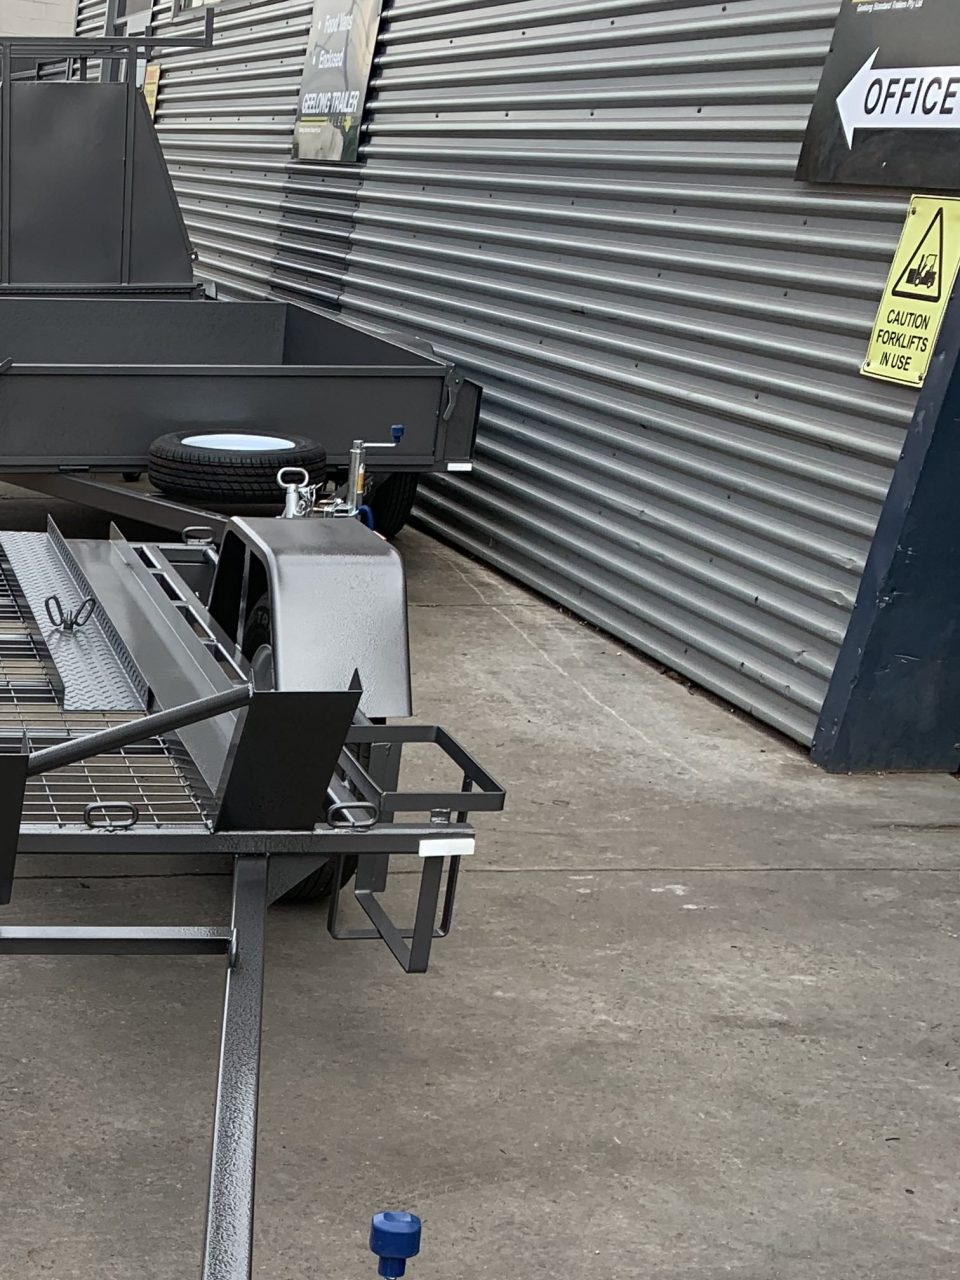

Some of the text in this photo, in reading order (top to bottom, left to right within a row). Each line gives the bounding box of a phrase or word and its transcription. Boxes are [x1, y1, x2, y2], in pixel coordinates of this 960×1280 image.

[302, 91, 360, 113] GEELONG TRAILER
[864, 77, 960, 115] OFFICE
[887, 309, 930, 330] CAUTION
[876, 329, 928, 352] FORKLIFTS
[880, 352, 912, 371] IN USE
